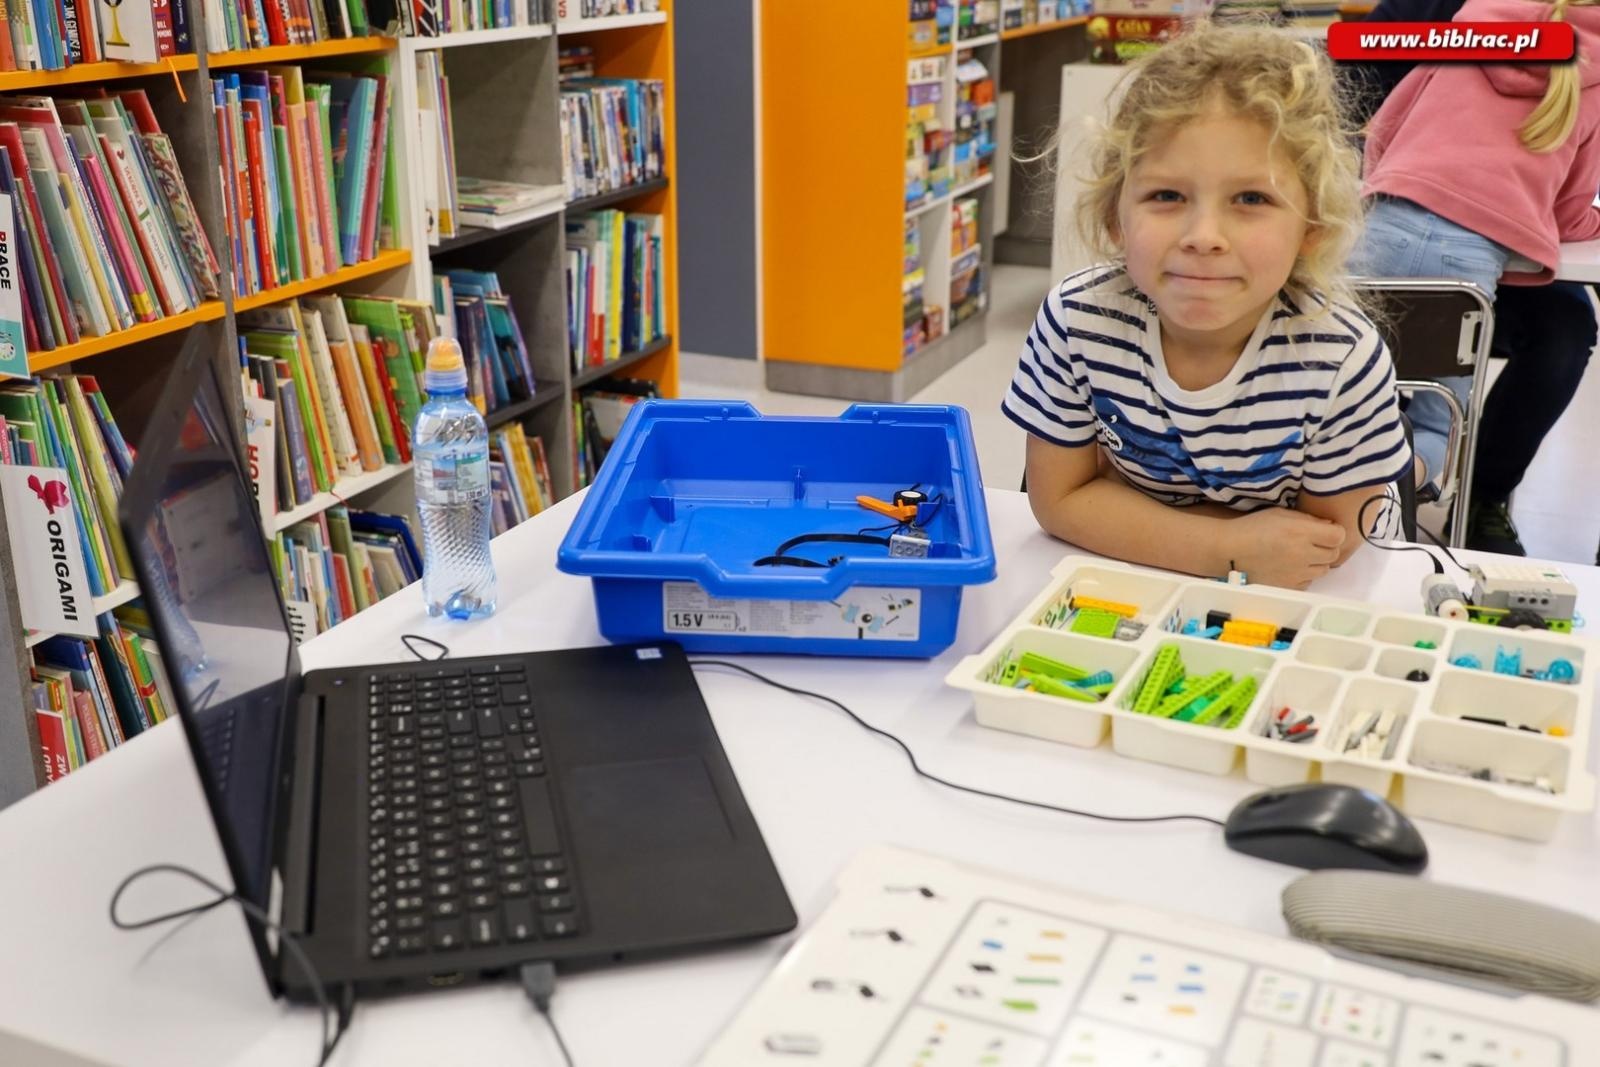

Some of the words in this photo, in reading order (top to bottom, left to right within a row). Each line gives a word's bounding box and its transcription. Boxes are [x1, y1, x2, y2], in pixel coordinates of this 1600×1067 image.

[46, 520, 78, 621] ORIGAMI
[673, 613, 691, 628] 1.5
[694, 613, 703, 627] V
